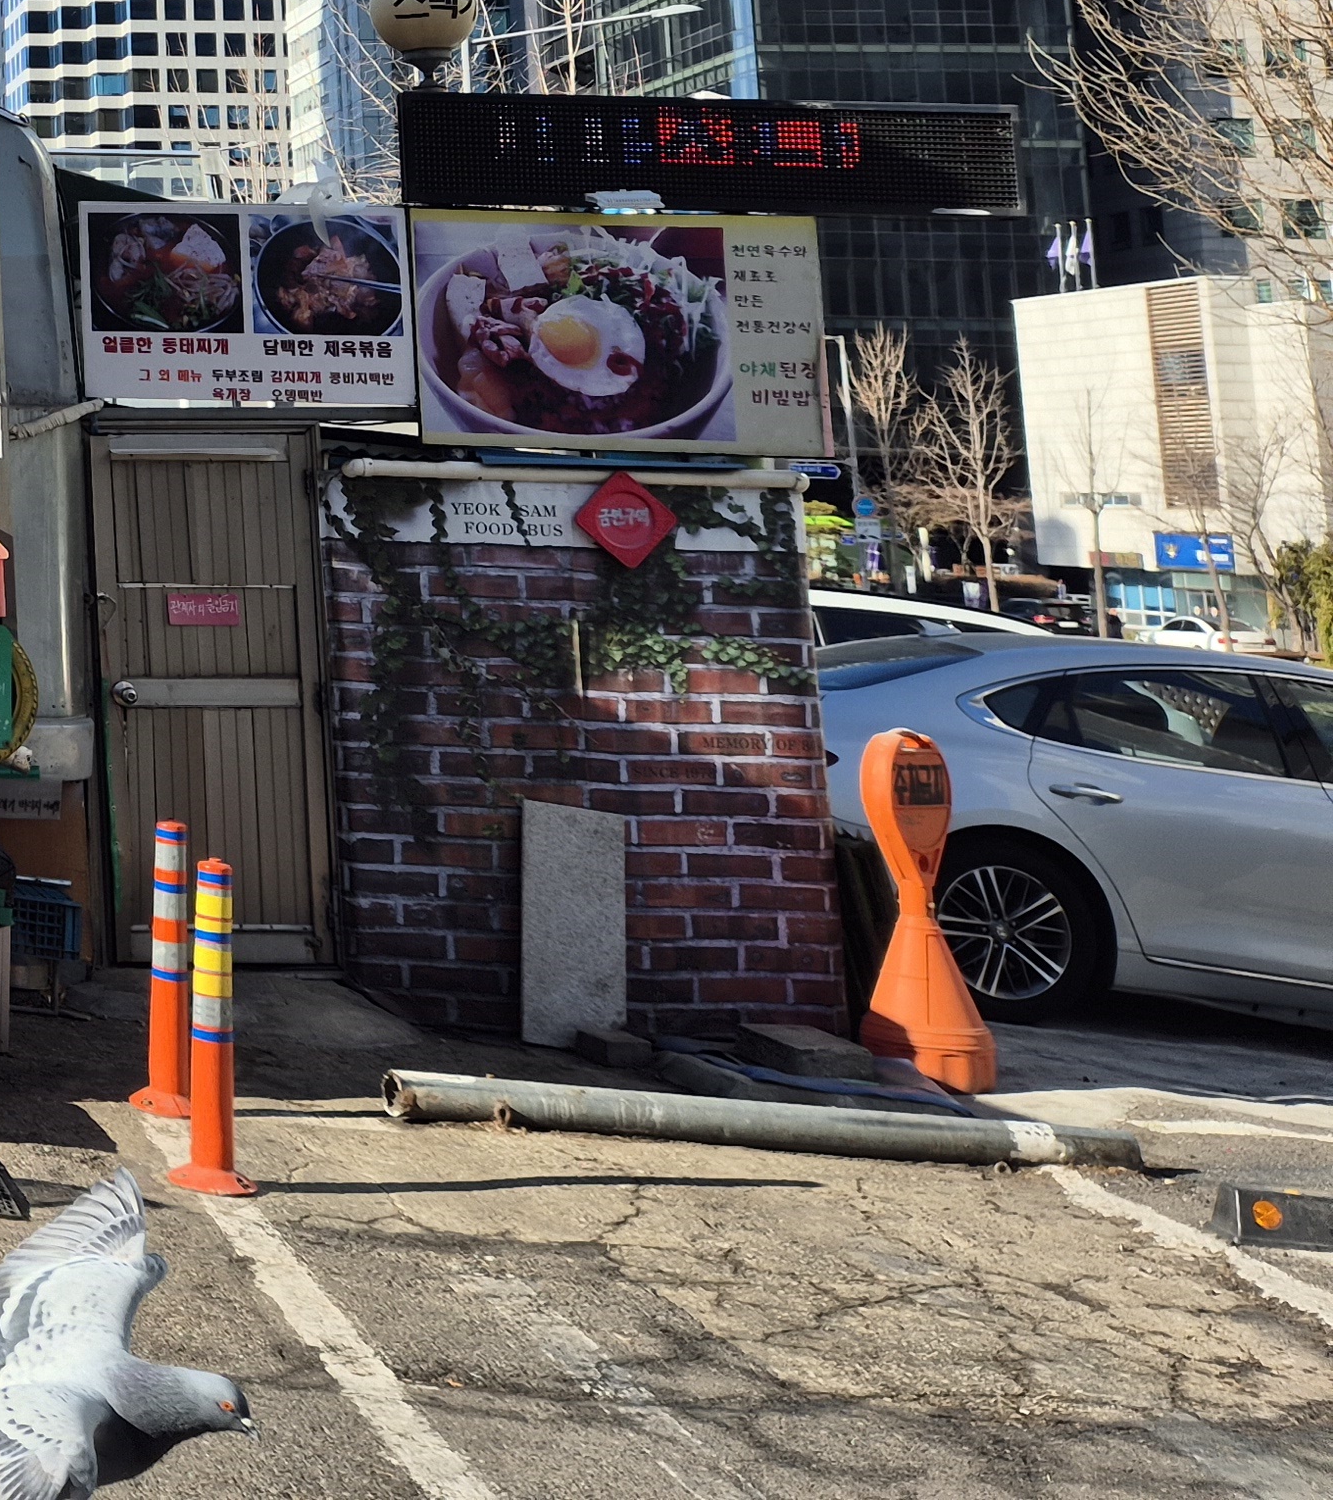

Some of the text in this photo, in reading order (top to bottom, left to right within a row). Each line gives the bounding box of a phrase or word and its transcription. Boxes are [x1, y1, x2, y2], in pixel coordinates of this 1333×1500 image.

[732, 244, 808, 259] 천연육수와
[734, 295, 763, 308] 만든
[737, 320, 811, 335] 전통건강식
[162, 337, 230, 356] 동태찌개
[263, 339, 393, 358] 담백한 제육볶음
[138, 369, 394, 386] 그 외 메뉴 두부조림 김치찌개 콩비지백반
[212, 387, 251, 401] 육개장
[752, 389, 811, 407] 비빔밥
[451, 503, 557, 517] YEOK SAM
[598, 507, 650, 527] 금연구역
[464, 522, 563, 537] FOOD BUS
[702, 736, 771, 750] MEMORY
[776, 738, 794, 750] OF
[634, 767, 679, 778] SINCE
